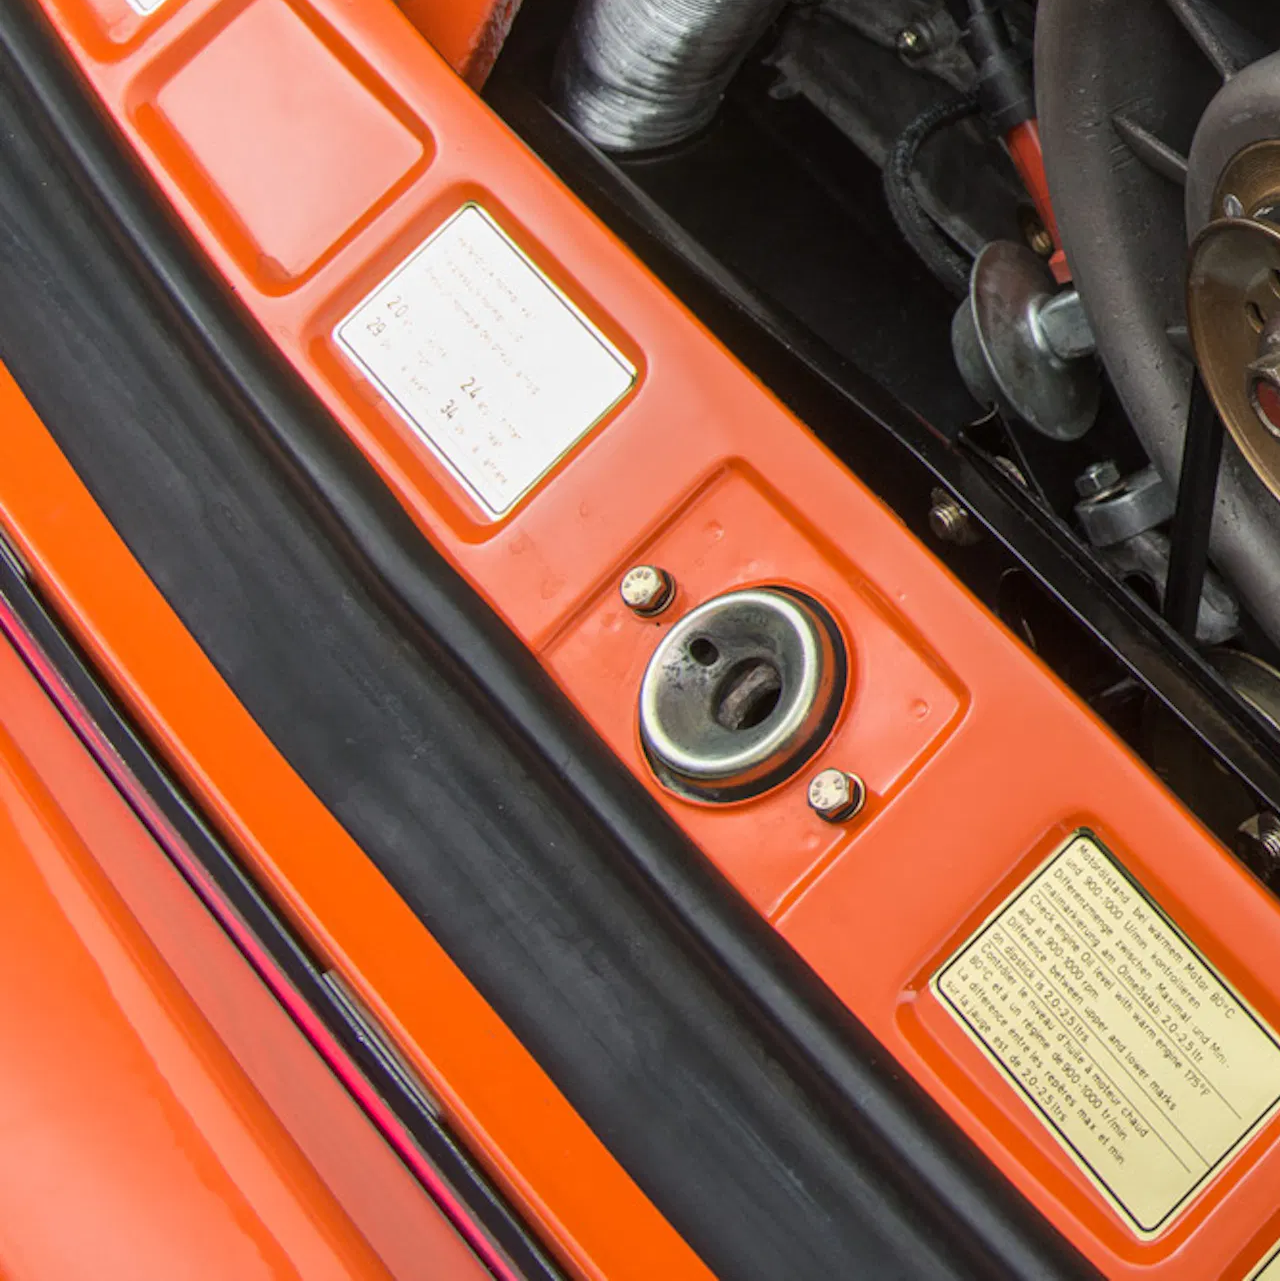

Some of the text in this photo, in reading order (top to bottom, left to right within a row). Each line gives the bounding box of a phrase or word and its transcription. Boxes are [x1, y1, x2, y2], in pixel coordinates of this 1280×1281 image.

[991, 931, 1004, 945] on
[1003, 945, 1035, 980] dipstick
[1033, 980, 1045, 992] is
[1017, 907, 1036, 926] and
[1033, 926, 1047, 938] at
[1043, 935, 1085, 981] 900-1000
[1028, 893, 1211, 1096] Check engine Oil level with warm engine 175°F
[1052, 867, 1114, 936] Differenzmenge
[1114, 938, 1152, 980] zwischen
[1191, 1025, 1211, 1045] und
[1064, 857, 1201, 1009] und 900-1000 U/min kontrollieren
[1100, 948, 1116, 963] am
[1131, 905, 1147, 924] bei
[1182, 961, 1209, 991] Motor
[956, 966, 969, 982] La
[1007, 1027, 1030, 1053] entre
[1027, 1050, 1043, 1069] les
[1097, 1133, 1110, 1146] et
[958, 993, 969, 1008] la
[965, 1007, 991, 1033] jauge
[992, 1035, 1009, 1053] est
[1008, 1054, 1021, 1068] de
[991, 982, 1003, 994] et
[1008, 1002, 1022, 1017] un
[1050, 1051, 1063, 1065] de
[1060, 1061, 1103, 1110] 900-1000
[1005, 915, 1177, 1111] Difference between upper and lower marks
[1017, 985, 1028, 999] le
[1027, 999, 1055, 1031] niveau
[1091, 1072, 1121, 1106] moteur
[1120, 1106, 1149, 1138] chaud
